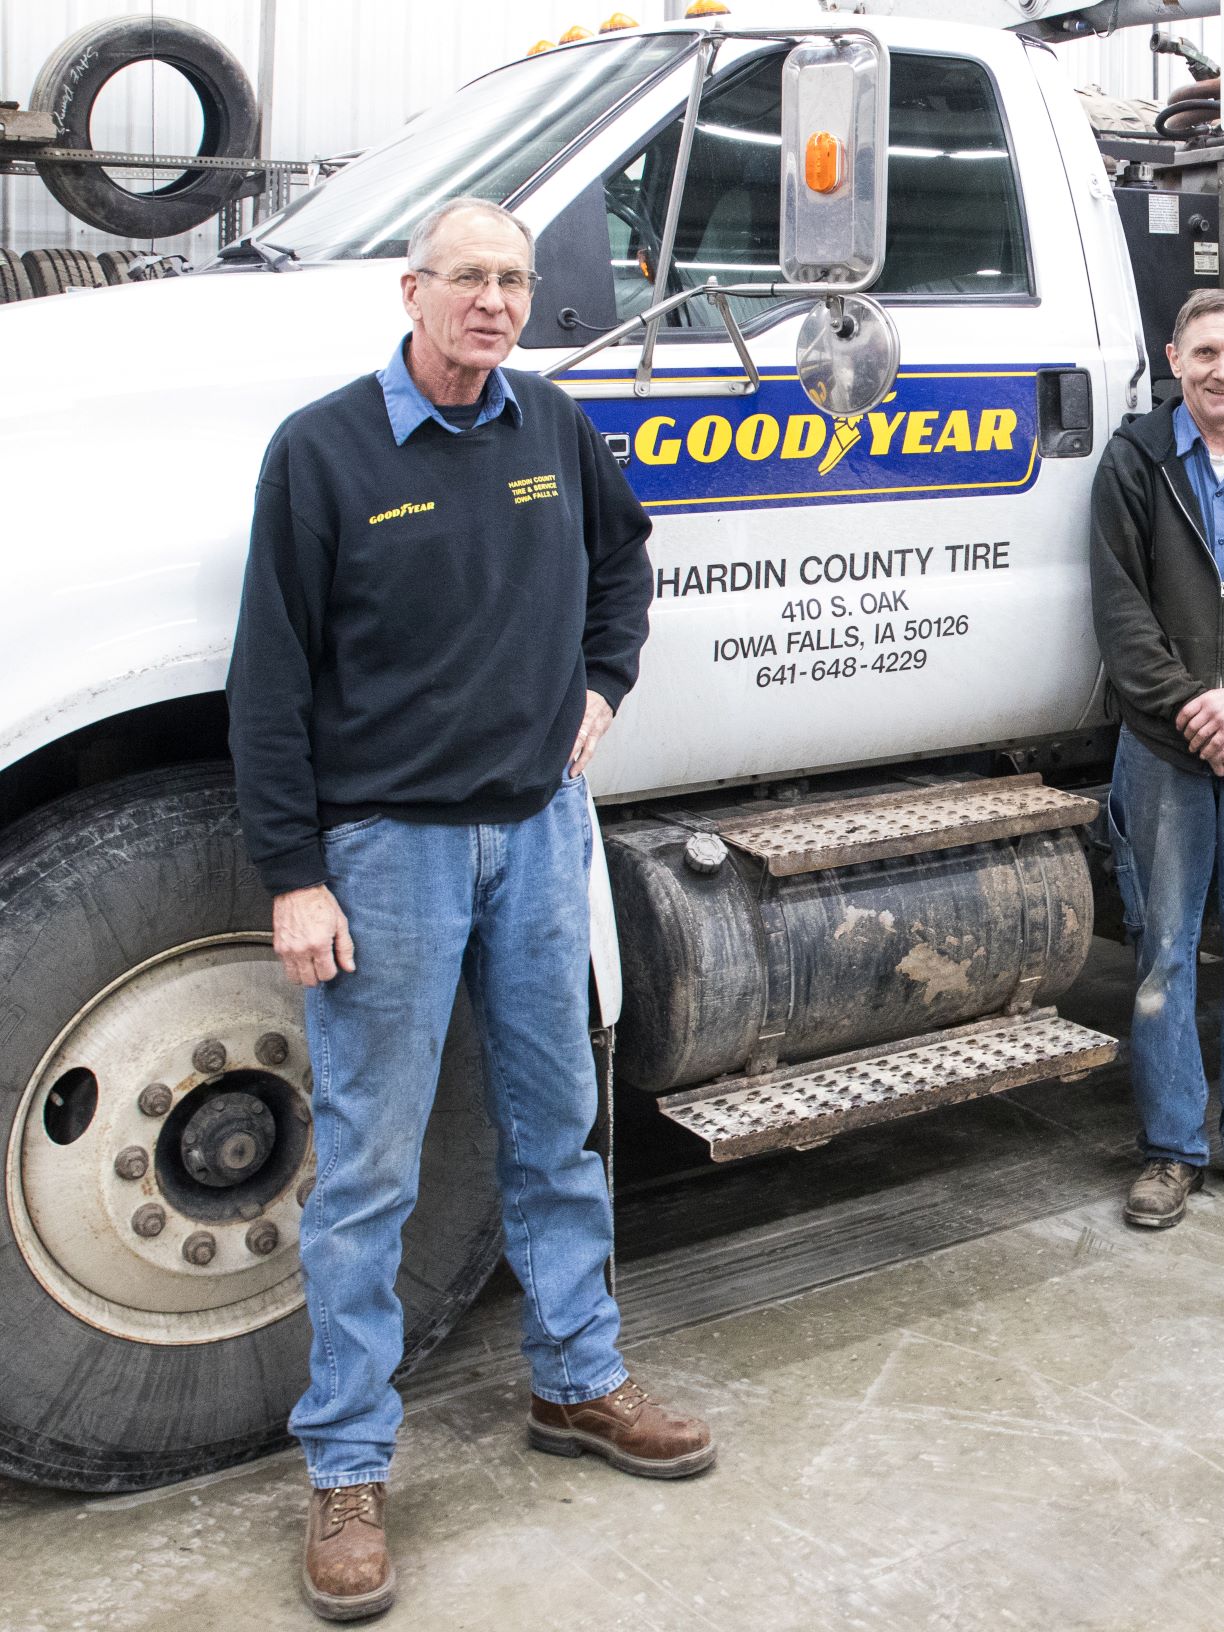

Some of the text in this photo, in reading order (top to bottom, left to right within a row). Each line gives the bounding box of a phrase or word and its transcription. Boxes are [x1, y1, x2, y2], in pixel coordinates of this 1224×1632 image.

[633, 407, 1018, 468] GOODYEAR
[508, 475, 556, 488] HARDIN COUNTY
[512, 487, 526, 496] TIRE
[533, 482, 557, 491] SERVICE
[369, 502, 435, 525] GOODYEAR
[515, 495, 532, 505] IOWA
[656, 541, 1011, 599] HARDIN COUNTY TIRE
[781, 589, 909, 624] 410 S. OAK
[713, 614, 969, 663] IOWA FALLS, IA 50126
[755, 648, 928, 689] 641-648-4229
